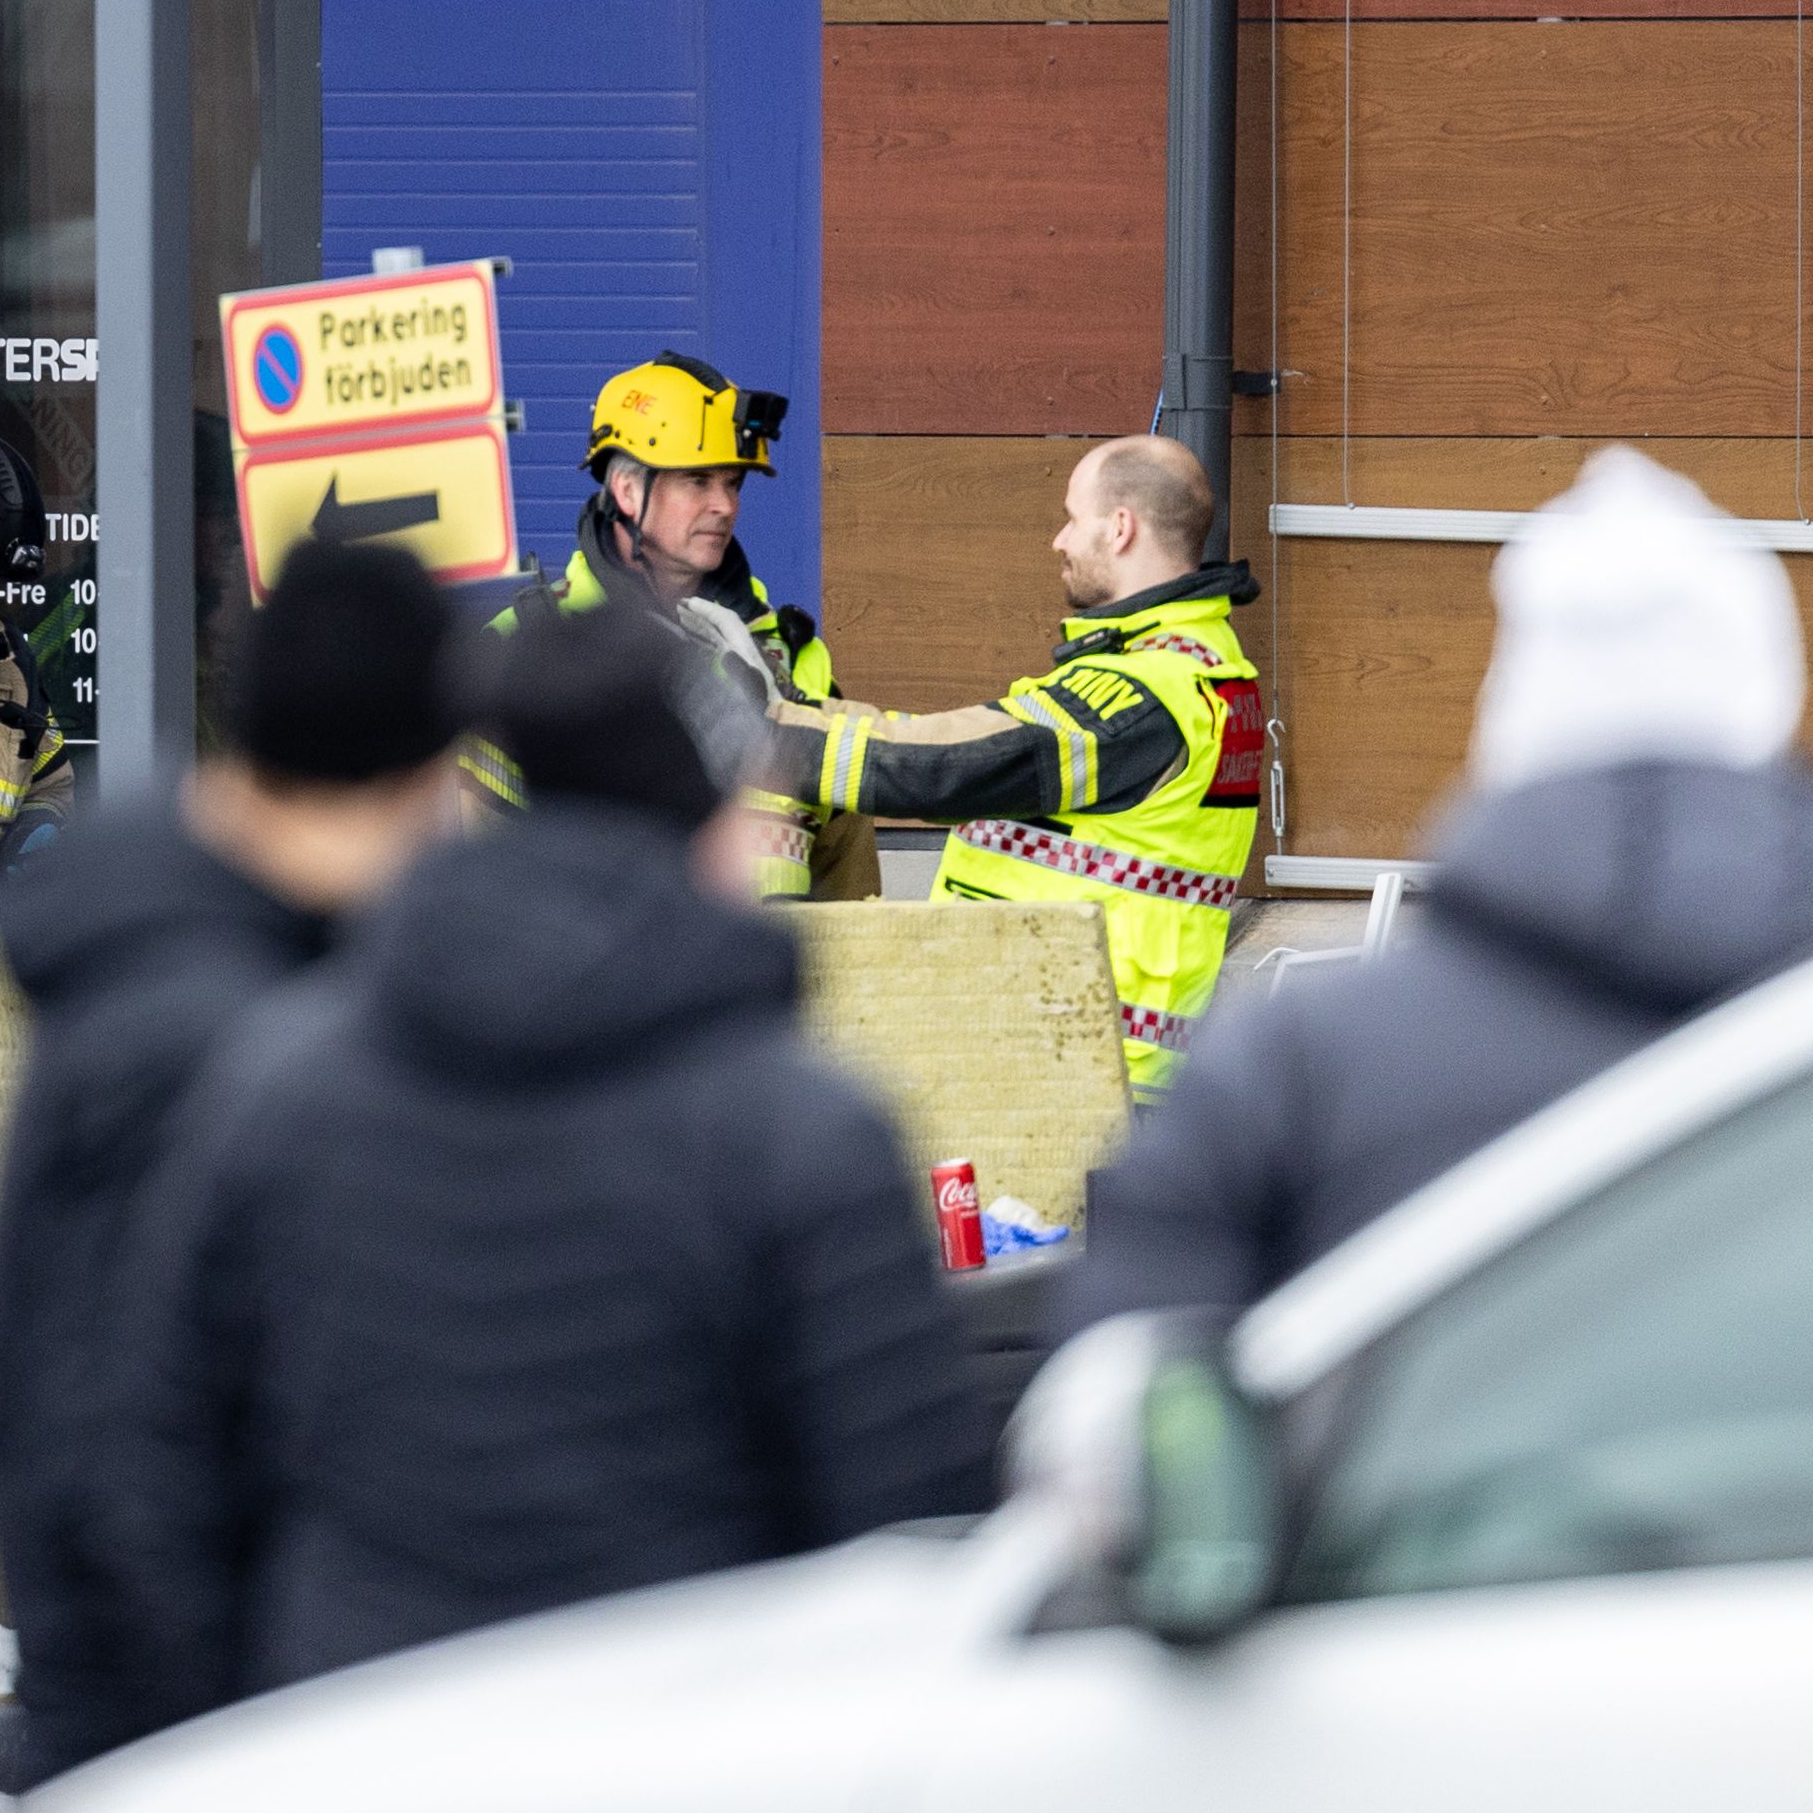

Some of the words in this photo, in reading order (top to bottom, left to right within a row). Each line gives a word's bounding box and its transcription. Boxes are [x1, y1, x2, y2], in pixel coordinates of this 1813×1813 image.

[320, 297, 467, 350] Parkering
[326, 352, 472, 405] förbjuden
[70, 579, 98, 605] 10
[70, 628, 99, 654] 10
